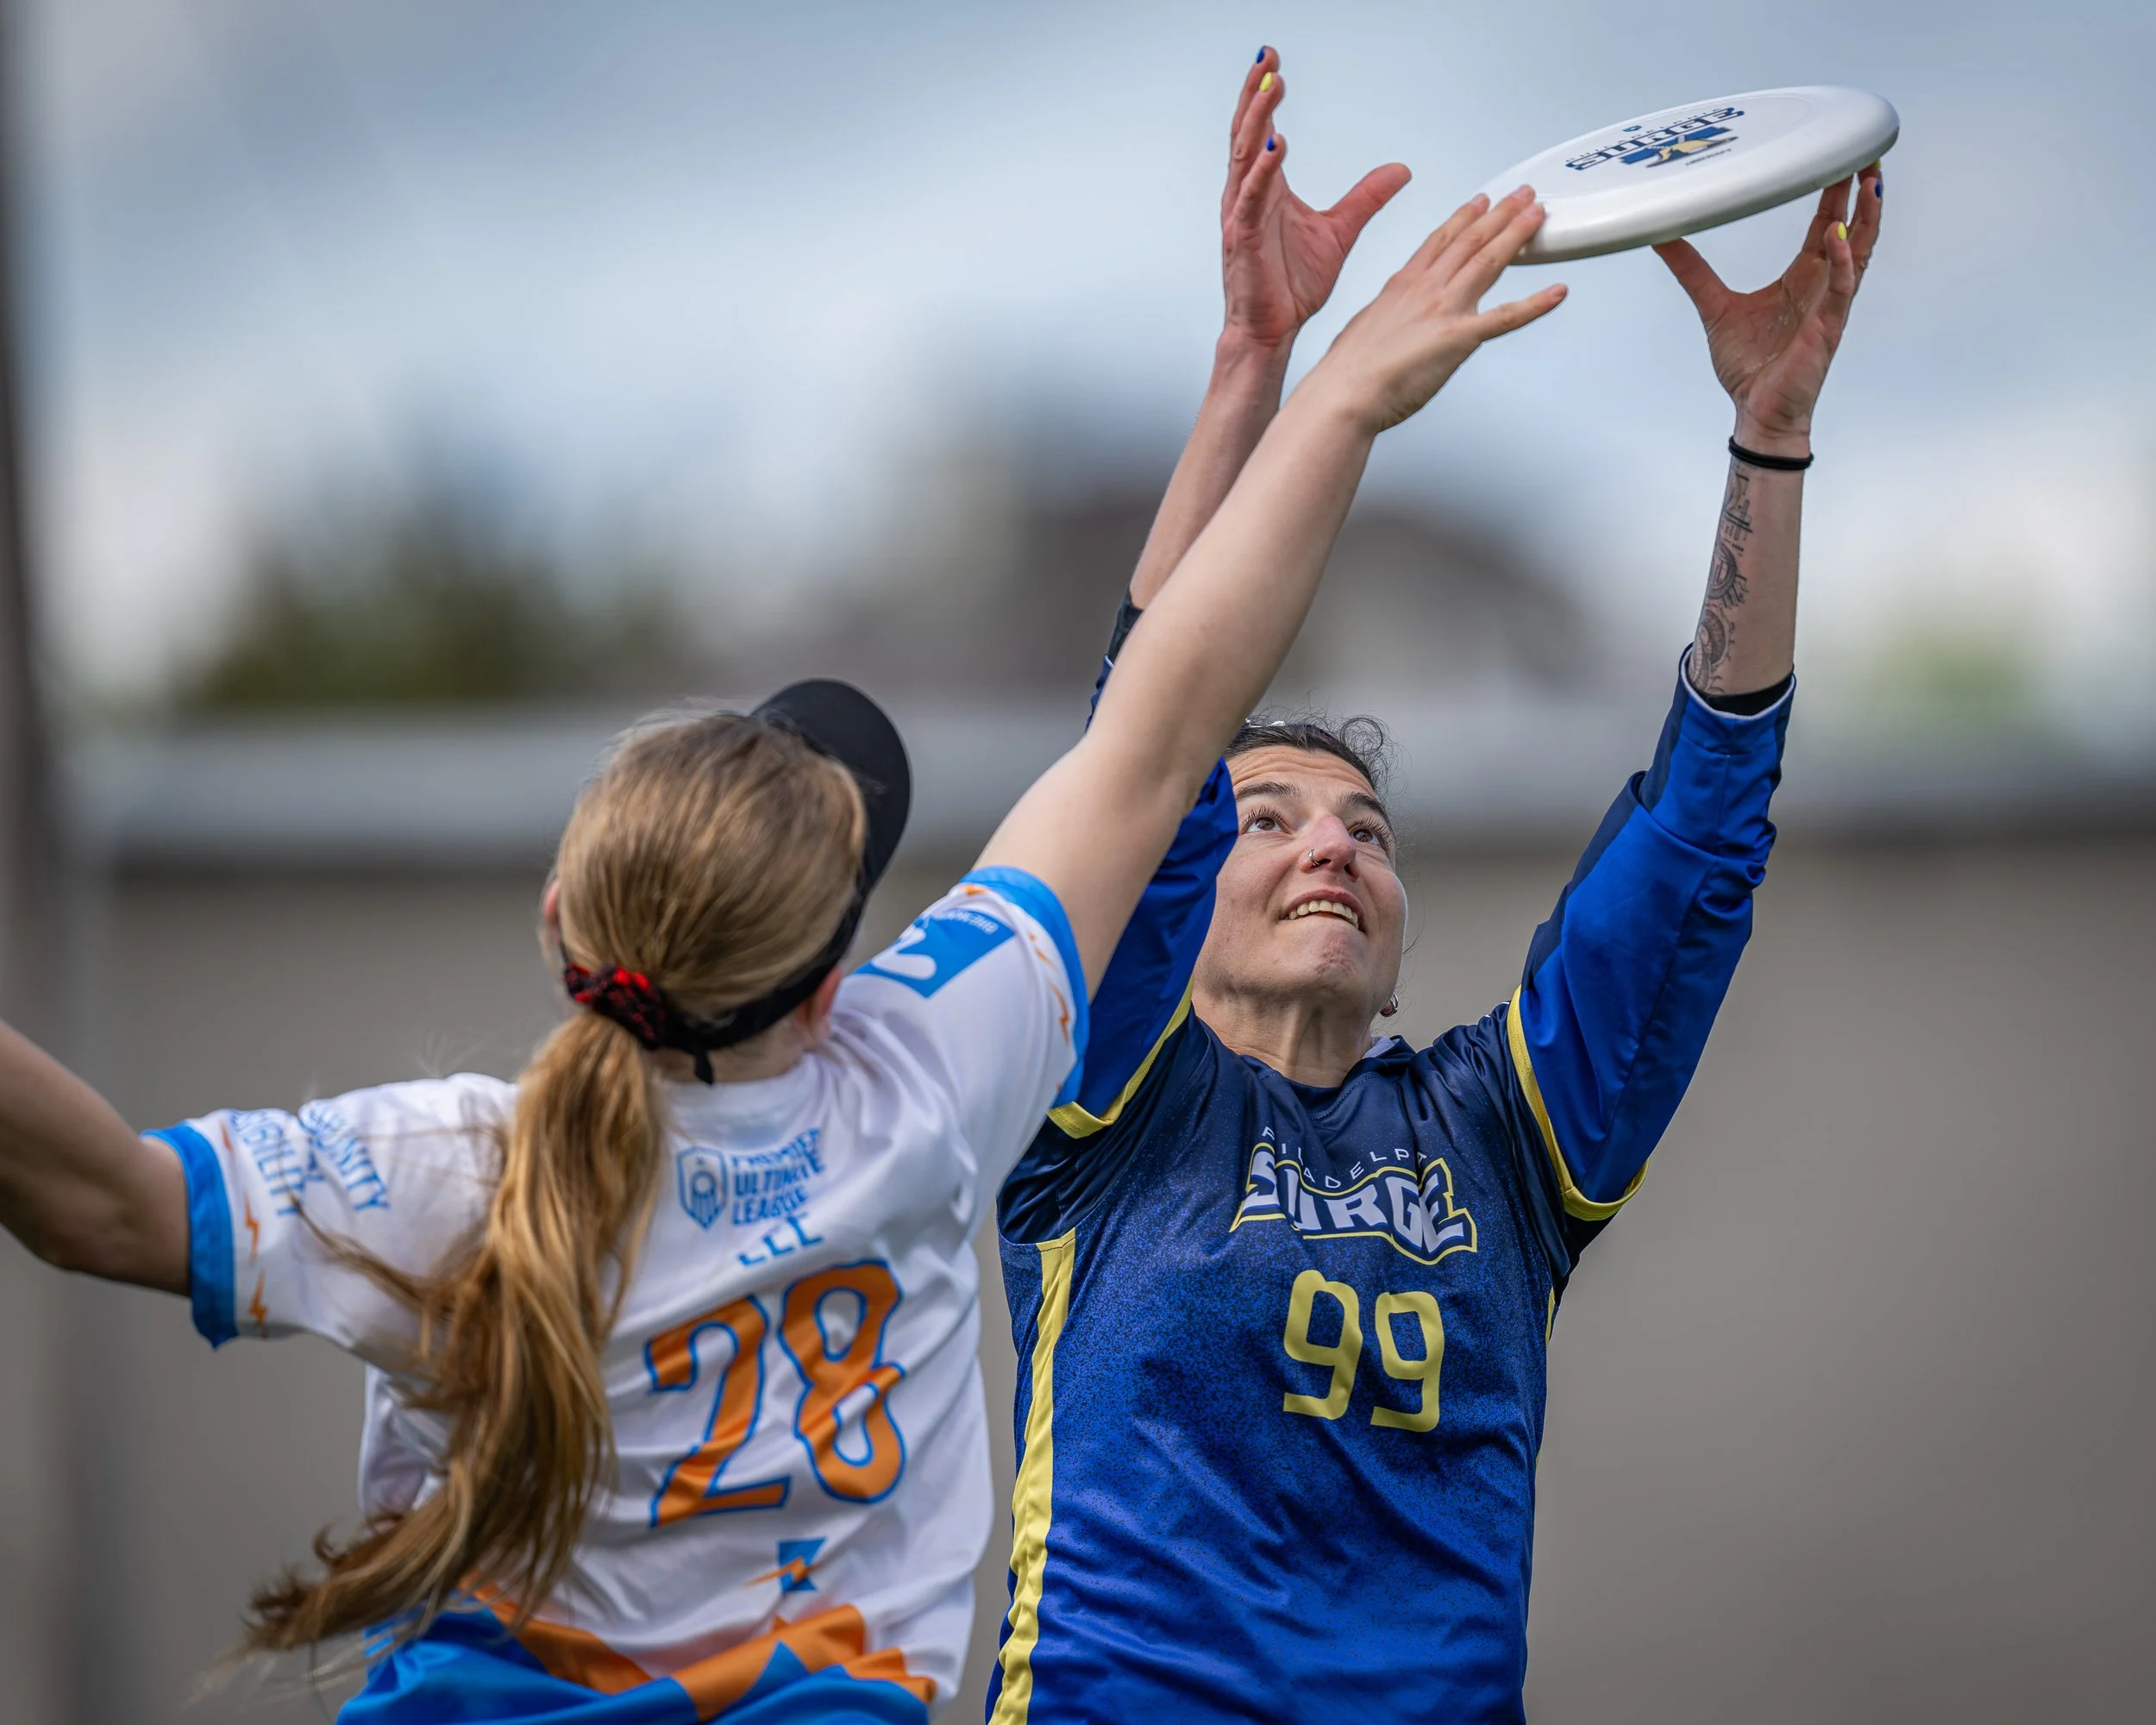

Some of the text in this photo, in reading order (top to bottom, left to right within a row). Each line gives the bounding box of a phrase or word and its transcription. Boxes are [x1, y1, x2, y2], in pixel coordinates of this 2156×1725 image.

[1565, 107, 1745, 171] SURGE
[1238, 1148, 1468, 1257] SURGE
[644, 1257, 907, 1530] 28
[1282, 1269, 1445, 1433] 99
